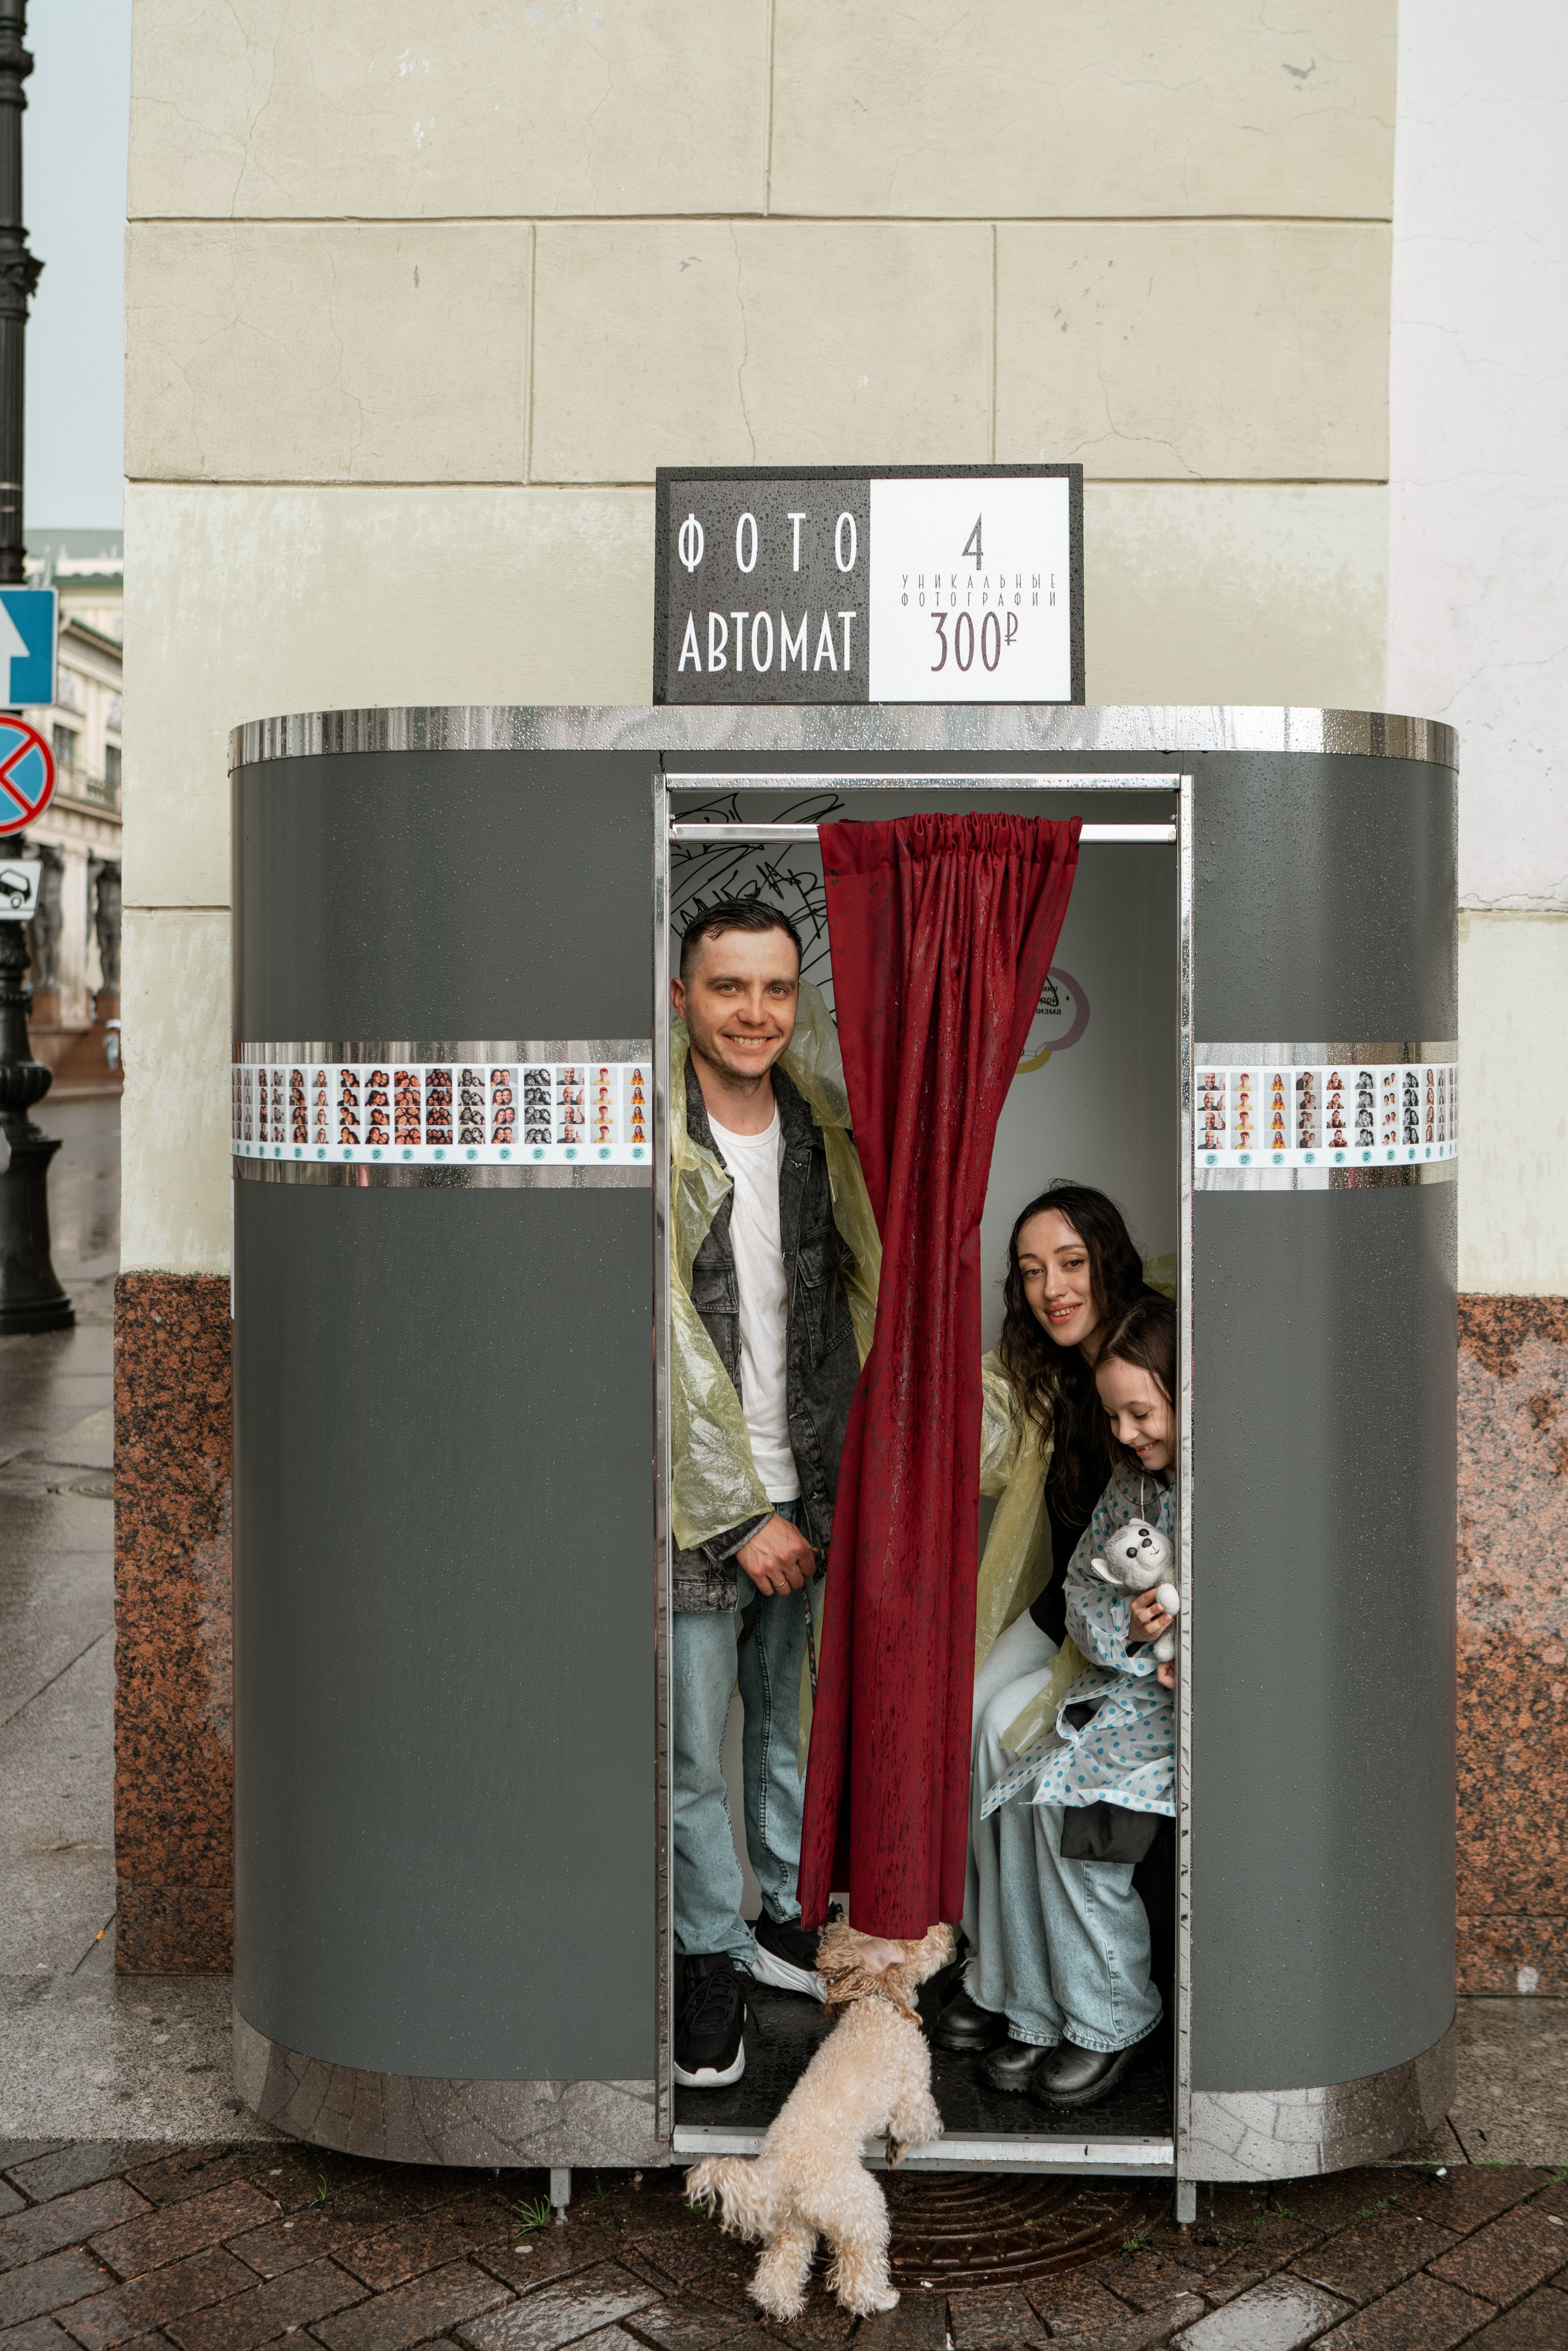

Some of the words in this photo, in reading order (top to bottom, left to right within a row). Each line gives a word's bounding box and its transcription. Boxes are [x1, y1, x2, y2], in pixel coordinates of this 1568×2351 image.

[678, 512, 858, 573] ФОТО
[962, 512, 984, 570] 4
[902, 574, 1055, 589] УНИКАЛЬНЫЕ
[902, 592, 1055, 606] ФОТОГРАФИИ
[678, 610, 857, 672] АВТОМАТ
